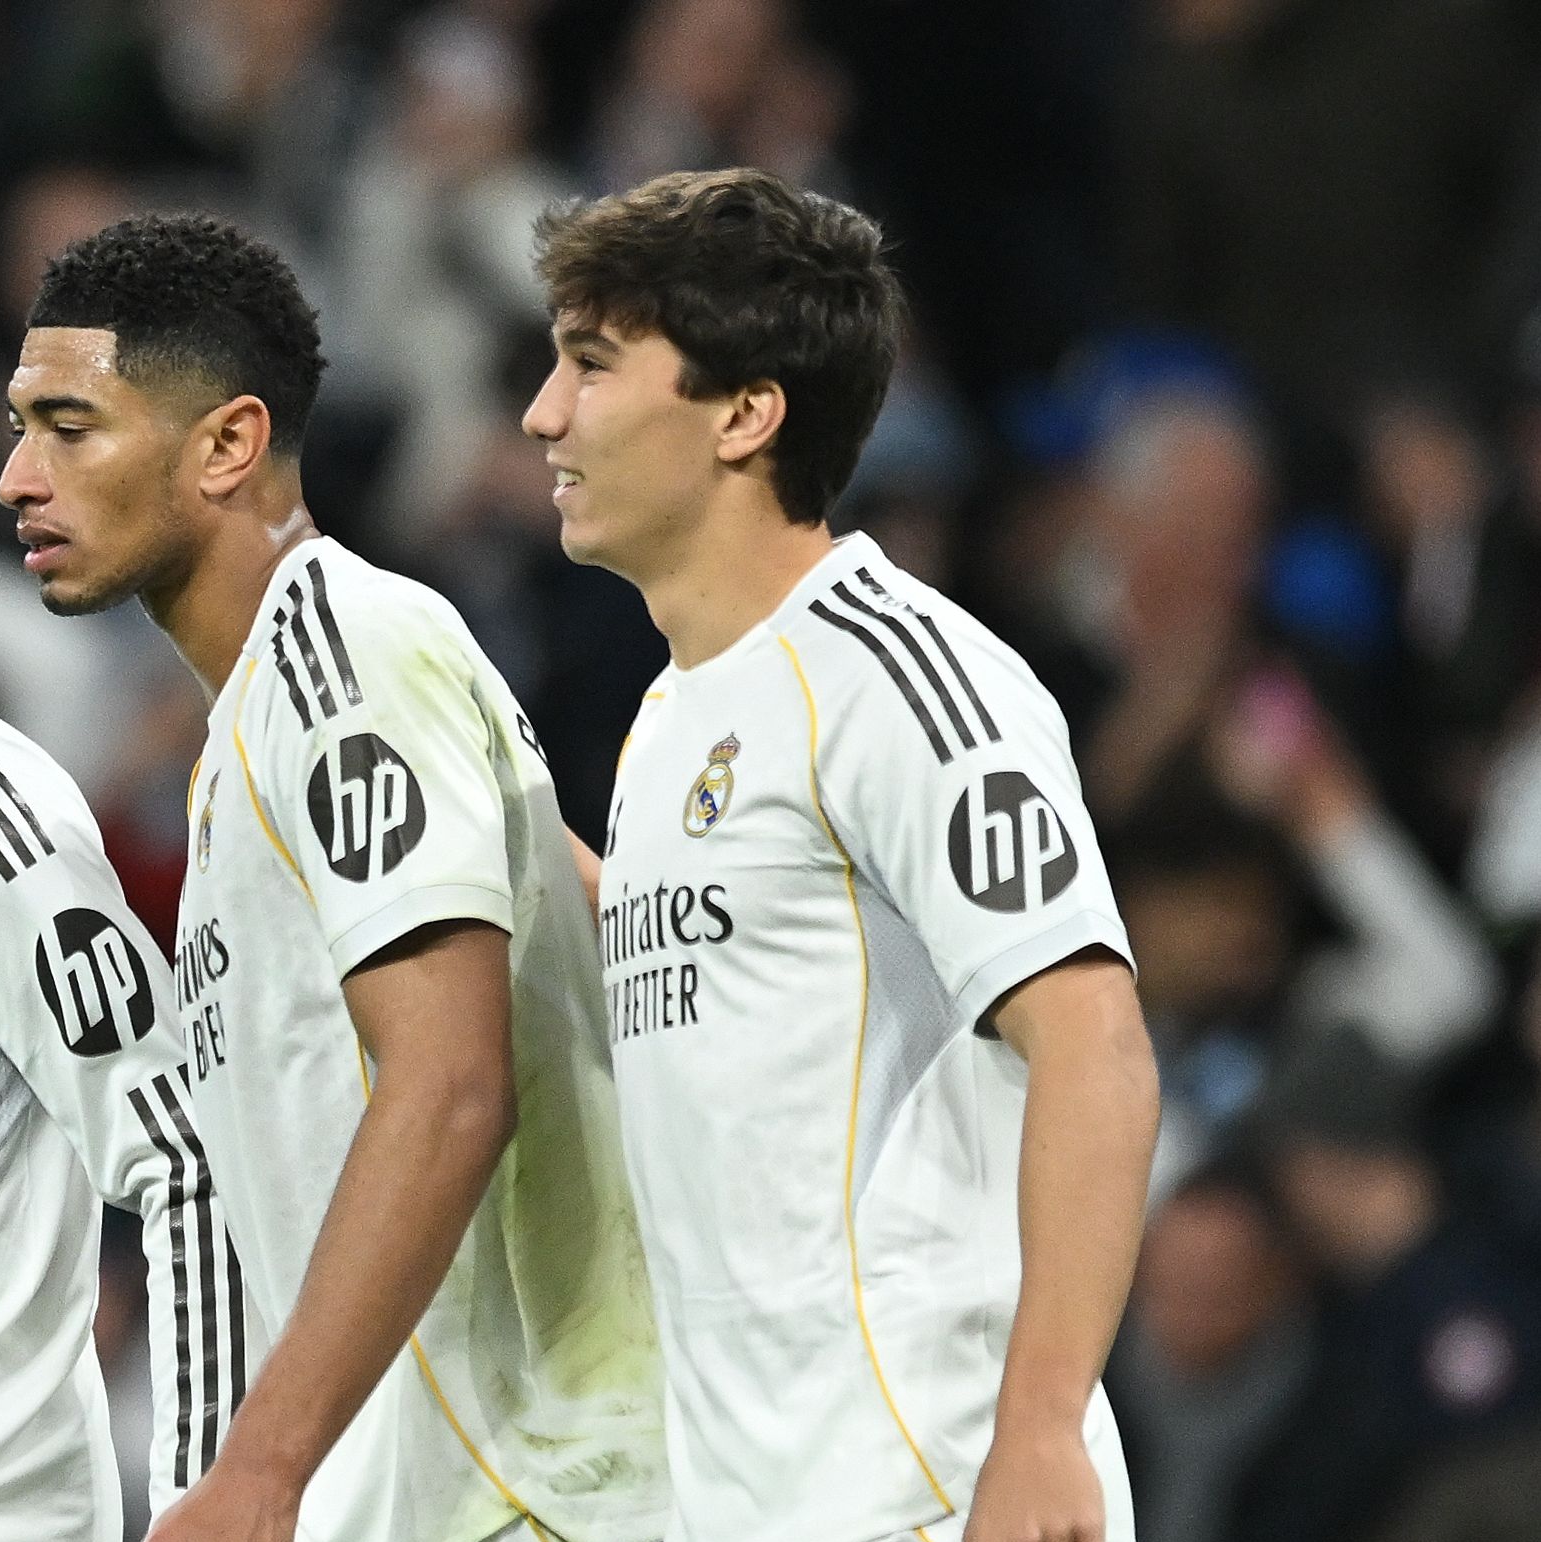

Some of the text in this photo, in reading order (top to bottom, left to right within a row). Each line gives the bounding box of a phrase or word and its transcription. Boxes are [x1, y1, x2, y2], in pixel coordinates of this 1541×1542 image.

[320, 738, 410, 881] hp
[964, 775, 1068, 913] hp
[48, 910, 146, 1056] hp
[601, 880, 734, 968] mirates
